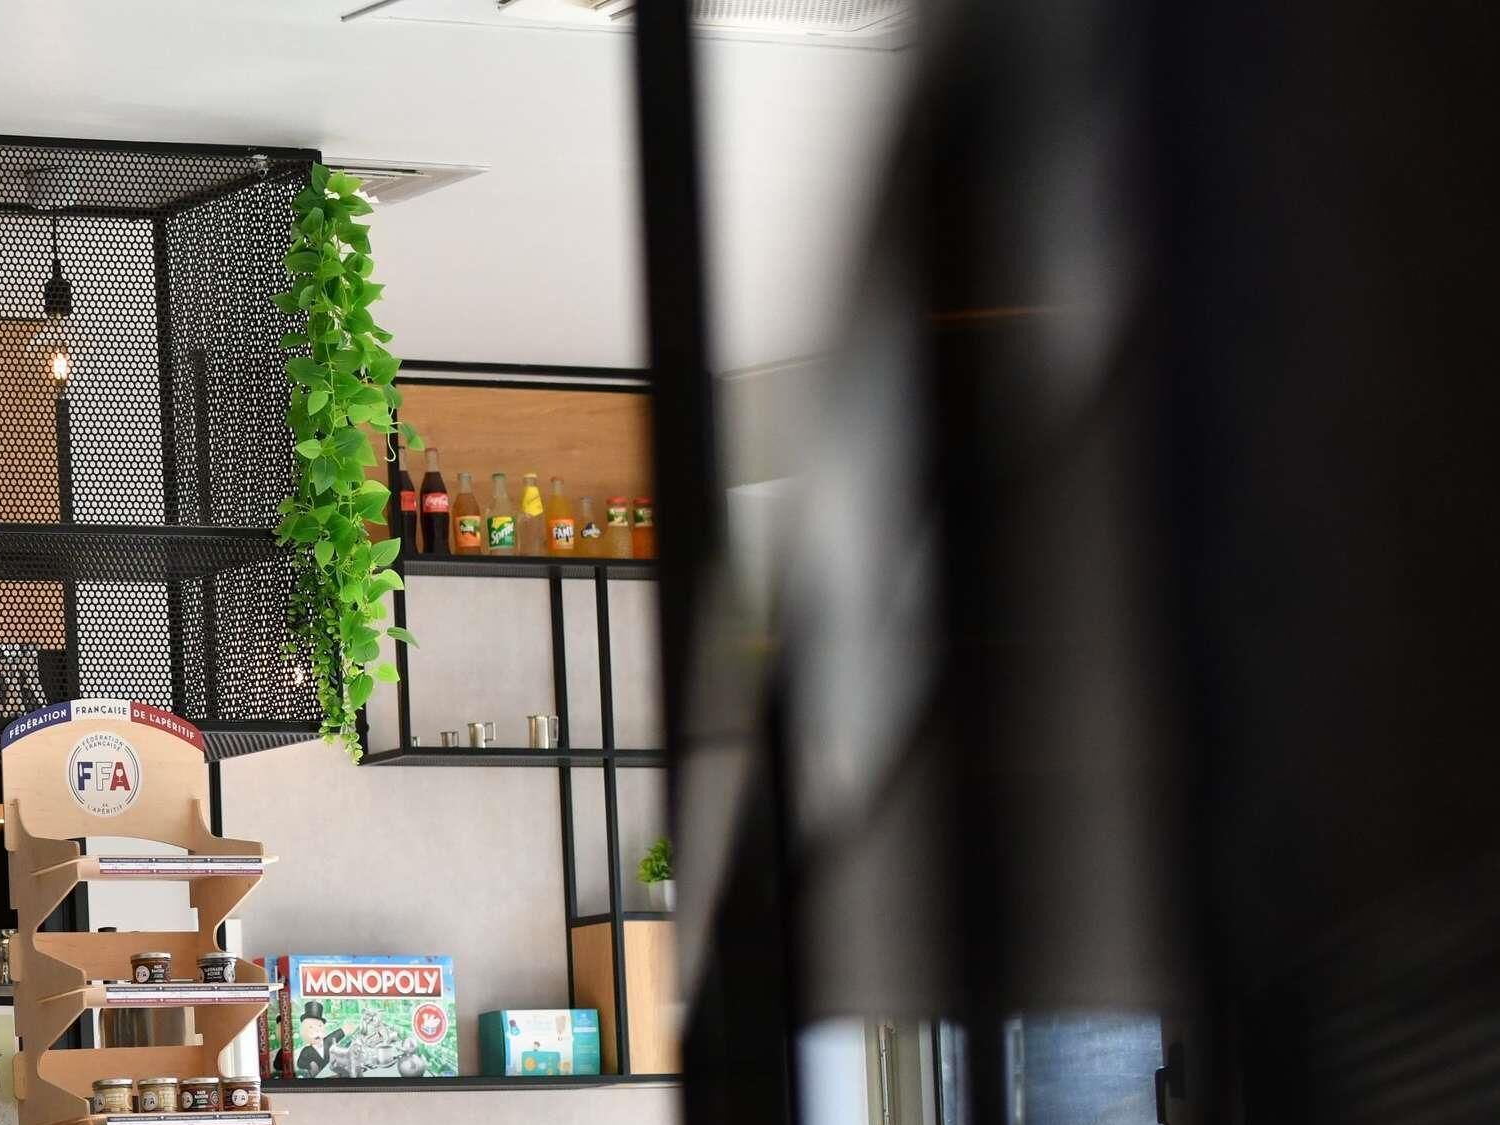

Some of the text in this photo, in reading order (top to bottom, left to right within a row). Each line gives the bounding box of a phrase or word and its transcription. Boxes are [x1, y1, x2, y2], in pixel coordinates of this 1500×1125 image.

[9, 705, 196, 741] FÉDÉRATION FRANÇAISE DE L'APÉRITIF
[76, 761, 131, 792] FFA
[303, 968, 439, 994] MONOPOLY
